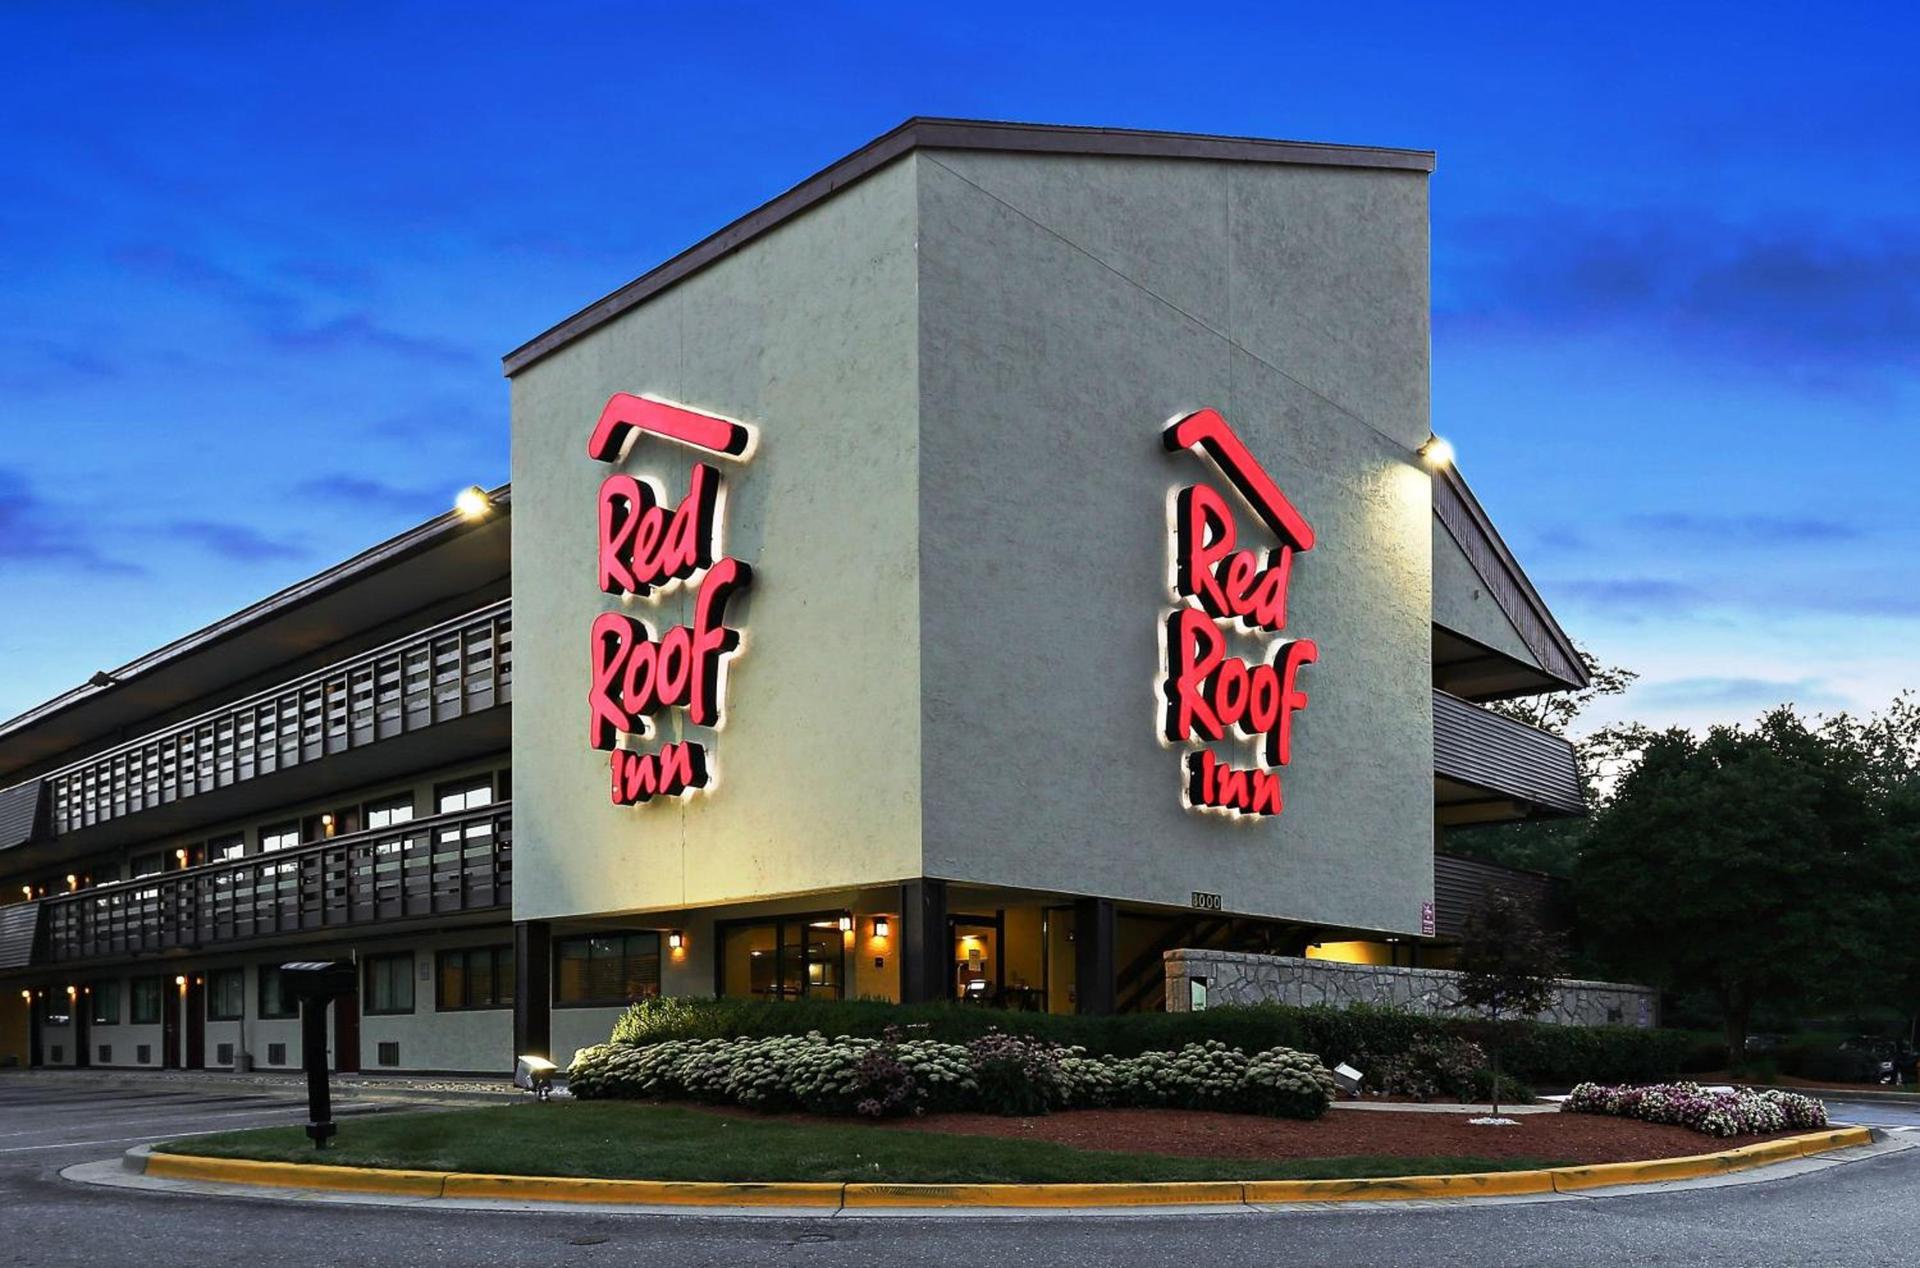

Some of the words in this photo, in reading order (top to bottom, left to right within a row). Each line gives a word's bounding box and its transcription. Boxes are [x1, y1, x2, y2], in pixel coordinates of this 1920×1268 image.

[599, 463, 704, 593] Red
[1190, 483, 1292, 631] Red
[588, 557, 739, 750] Roof
[1177, 607, 1318, 766] Roof
[611, 740, 694, 806] Inn
[1202, 748, 1284, 815] Inn
